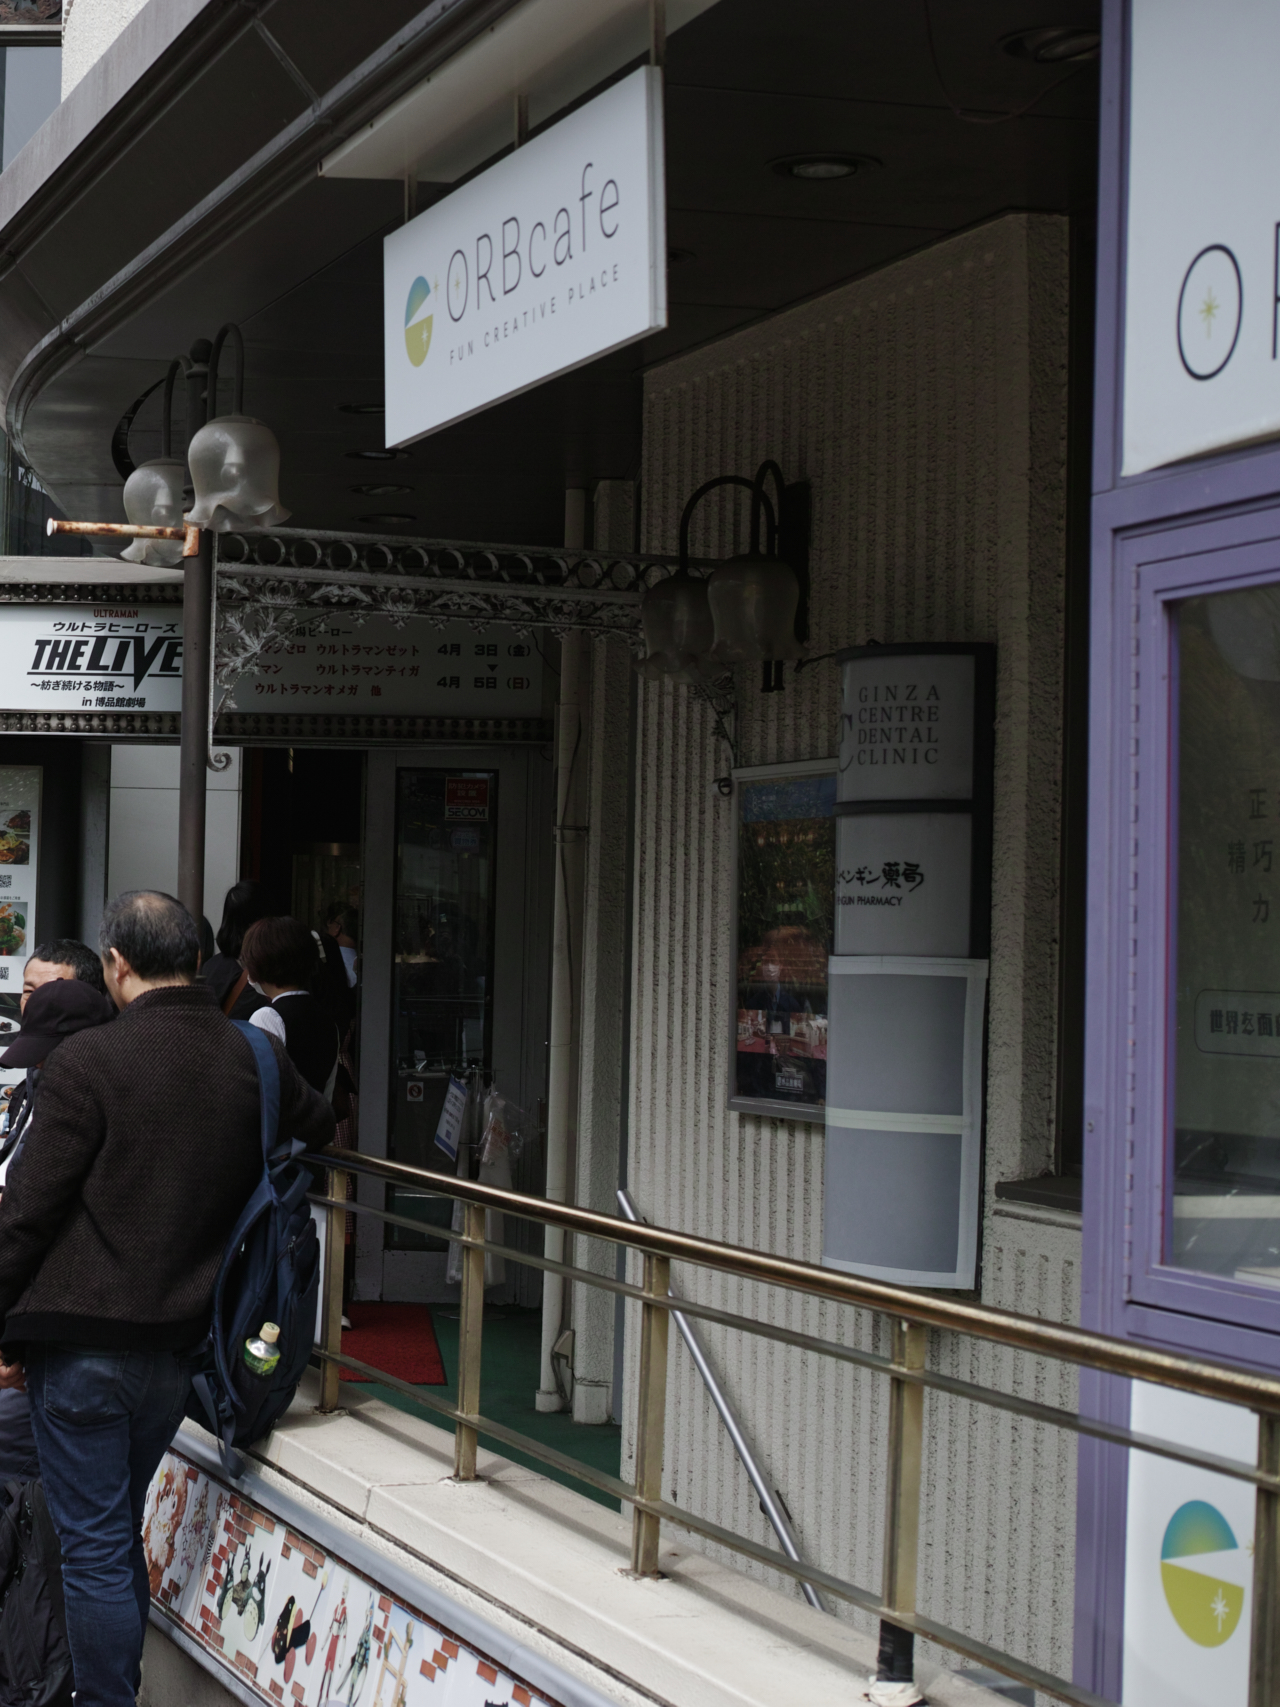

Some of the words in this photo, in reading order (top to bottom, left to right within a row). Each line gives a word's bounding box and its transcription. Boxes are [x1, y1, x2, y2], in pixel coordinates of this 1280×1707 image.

[446, 162, 619, 322] ORBcafe
[449, 338, 474, 365] FUN
[483, 296, 556, 348] CREATIVE
[568, 263, 619, 304] PLACE
[93, 609, 139, 618] ULTRAMAN
[53, 621, 179, 634] ウルトラヒーローズ
[286, 627, 353, 639] 場ヒーロー
[316, 644, 420, 657] ウルトラマンゼット
[437, 644, 461, 656] 4月
[31, 639, 89, 670] THE
[86, 636, 183, 693] LIVE
[316, 664, 420, 677] ウルトラマンティガ
[437, 676, 460, 688] 4月
[254, 683, 359, 696] ウルトラマンオメガ
[371, 685, 382, 696] 他
[858, 684, 941, 703] GINZA
[82, 697, 92, 707] in
[94, 696, 146, 708] 博品館劇場
[858, 705, 939, 724] CENTRE
[857, 726, 939, 744] DENTAL
[857, 747, 939, 765] CLINIC
[448, 807, 486, 817] SECOM
[857, 896, 903, 906] PHARMACY
[1210, 1009, 1280, 1037] 世界を面
